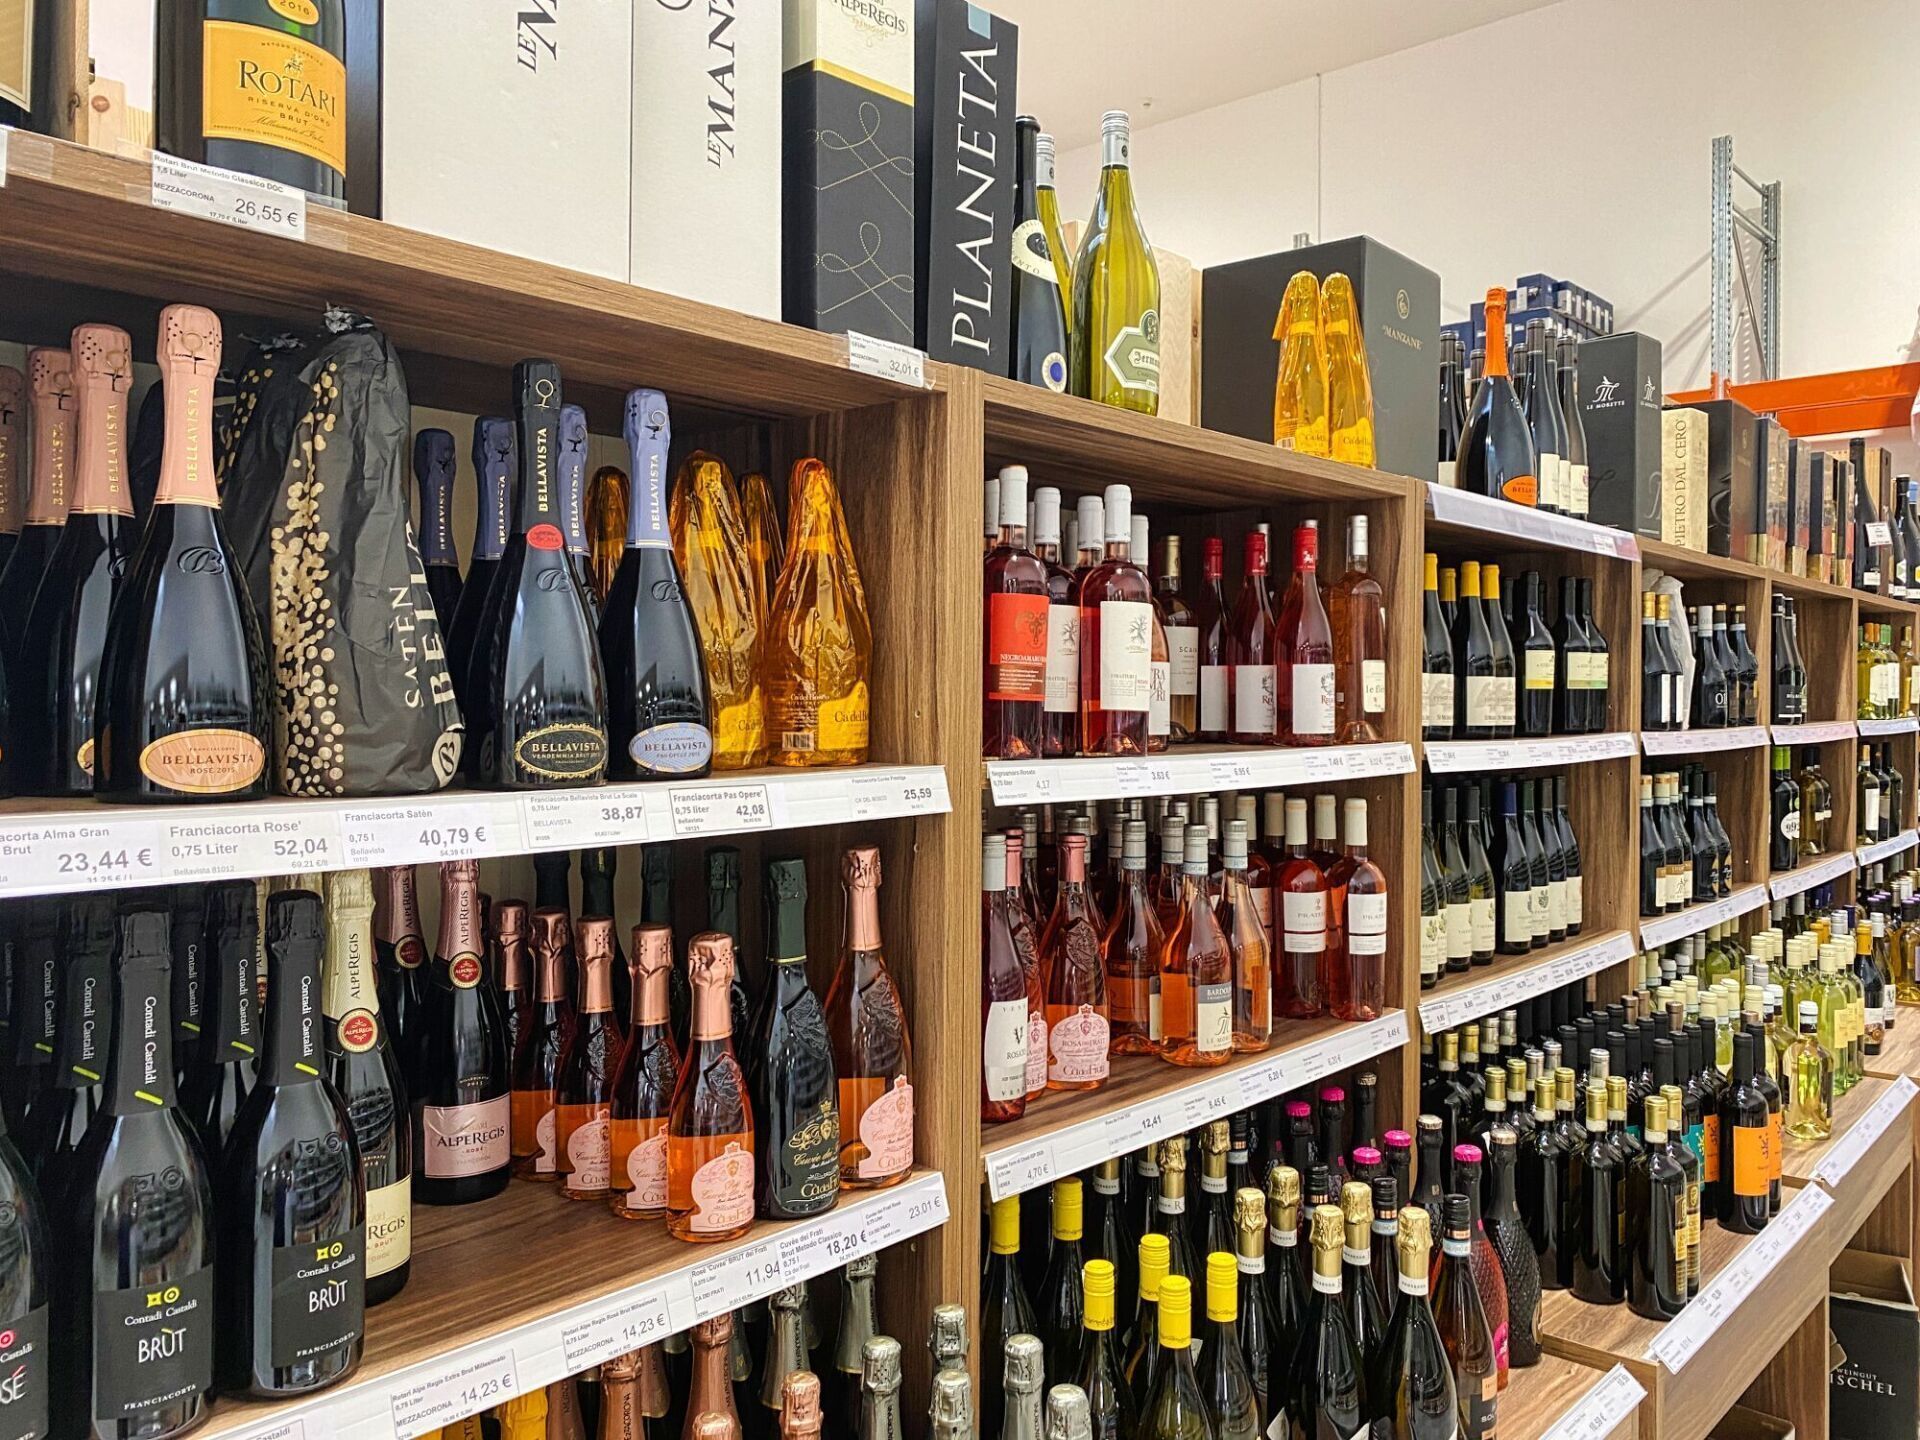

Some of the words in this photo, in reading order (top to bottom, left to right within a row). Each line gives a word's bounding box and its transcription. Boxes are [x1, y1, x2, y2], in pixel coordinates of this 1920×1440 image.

[517, 33, 537, 74] LE
[240, 60, 336, 118] ROTARI
[248, 96, 300, 114] RISERVA
[304, 110, 331, 128] D'ORO
[279, 113, 309, 127] BRUT
[154, 153, 179, 168] Rotari
[180, 161, 199, 172] Brut
[200, 167, 231, 181] Metodo
[231, 174, 266, 189] Classico
[266, 182, 285, 194] DOC
[169, 167, 188, 179] Liter
[153, 182, 216, 203] MEZZACORONA
[950, 42, 999, 357] PLANETA
[235, 197, 282, 224] 26,55
[286, 210, 299, 228] €
[187, 386, 200, 482] BELLAVISTA
[1674, 418, 1689, 461] CERO
[106, 403, 119, 494] BELLAVISTA
[538, 427, 548, 513] BELLAVISTA
[1674, 463, 1687, 492] DAL
[571, 464, 580, 538] BELLAVISTA
[651, 453, 660, 531] BELLAVISTA
[1673, 493, 1687, 547] PIETRO
[162, 753, 254, 766] BELLAVISTA
[532, 742, 600, 752] BELLAVISTA
[644, 740, 707, 752] BELLAVISTA
[530, 795, 568, 803] Franciacorta
[673, 792, 723, 802] Franciacorta
[723, 791, 738, 799] Pas
[738, 789, 763, 800] Opere'
[903, 787, 932, 802] 25,59
[344, 811, 405, 822] Franciacorta
[406, 809, 433, 819] Satèn
[601, 806, 643, 822] 38,87
[692, 805, 710, 814] liter
[736, 804, 765, 817] 42,08
[0, 830, 40, 843] acorta
[43, 828, 76, 841] Alma
[79, 826, 111, 838] Gran
[170, 823, 261, 838] Franciacorta
[263, 820, 302, 833] Rose'
[348, 832, 369, 843] 0,75
[419, 826, 469, 848] 40,79
[474, 826, 487, 842] €
[2, 845, 32, 856] Brut
[171, 844, 202, 859] 0,75
[206, 843, 239, 855] Liter
[273, 837, 328, 857] 52,04
[350, 847, 385, 856] Bellavista
[57, 850, 129, 875] 23,44
[137, 848, 153, 867] €
[458, 890, 469, 946] ALPEREGIS
[238, 959, 249, 996] Contadi
[348, 933, 361, 1000] ALPEREGIS
[84, 977, 96, 1017] Contadi
[301, 976, 313, 1016] Contadi
[145, 996, 157, 1039] Contadi
[239, 996, 250, 1036] Castaldi
[82, 1019, 95, 1061] Castaldi
[301, 1017, 313, 1058] Castaldi
[144, 1041, 156, 1085] Castaldi
[437, 1126, 505, 1148] ALPEREGIS
[368, 1215, 406, 1240] REGIS
[779, 1238, 800, 1250] Cuvée
[800, 1234, 809, 1243] dei
[809, 1228, 824, 1239] Frati
[781, 1249, 795, 1259] Brut
[795, 1241, 818, 1254] Metodo
[817, 1230, 843, 1246] Classico
[826, 1233, 858, 1257] 18,20
[860, 1229, 868, 1243] €
[297, 1259, 330, 1279] Contadi
[331, 1252, 356, 1271] Castaldi
[691, 1267, 707, 1278] Rosé
[754, 1245, 768, 1255] Frati
[745, 1260, 781, 1286] 11,94
[308, 1279, 349, 1313] BRÙT
[124, 1311, 163, 1326] Contadi
[166, 1299, 198, 1317] Castaldi
[622, 1318, 656, 1341] 14,23
[656, 1313, 666, 1326] €
[0, 1342, 34, 1364] Castaldi
[138, 1327, 188, 1364] BRÙT
[296, 1331, 356, 1357] FRANCIACORTA
[566, 1336, 615, 1360] MEZZACORONA
[426, 1377, 444, 1389] Regis
[460, 1366, 475, 1377] Brut
[1836, 1367, 1878, 1381] WEINGUT
[124, 1383, 198, 1411] FRANCIACORTA
[460, 1379, 500, 1405] 14,23
[502, 1373, 513, 1389] €
[395, 1400, 453, 1428] MEZZACORONA
